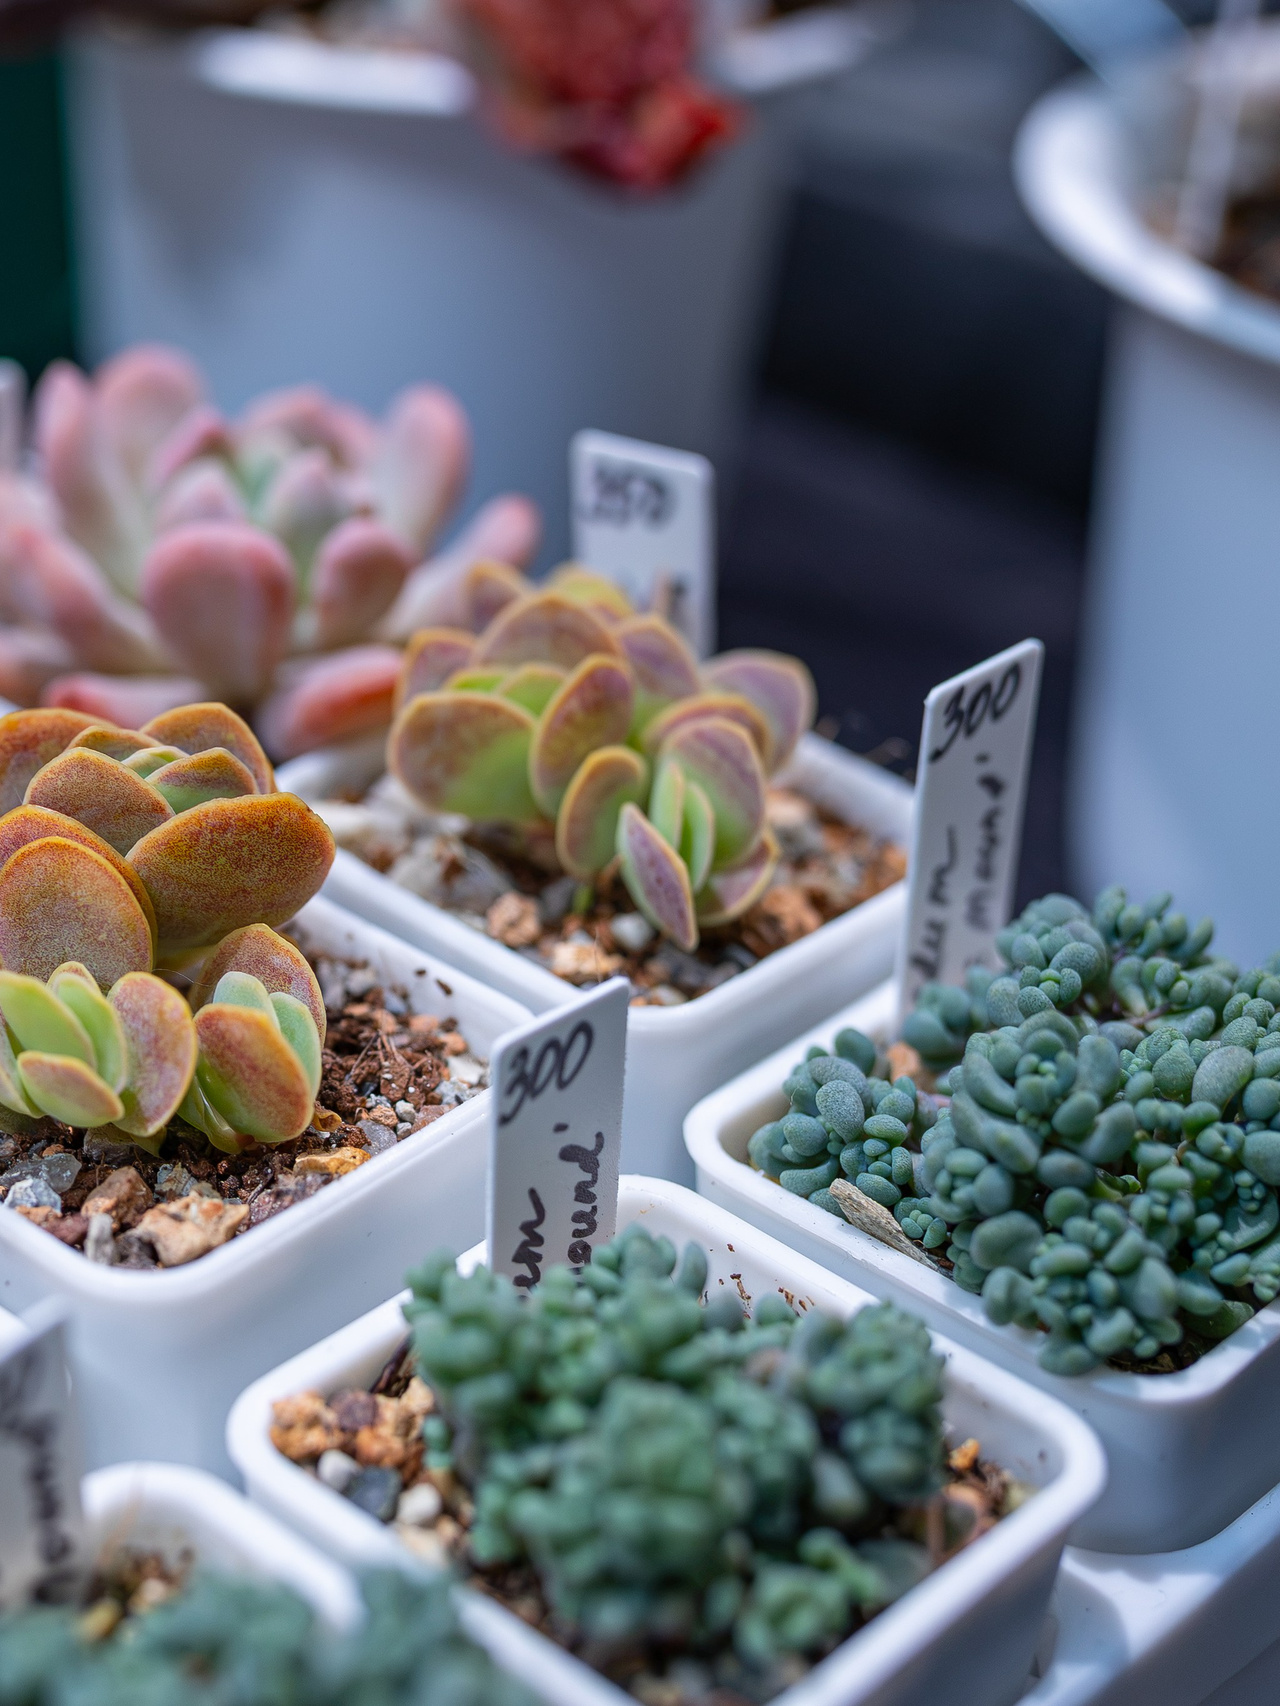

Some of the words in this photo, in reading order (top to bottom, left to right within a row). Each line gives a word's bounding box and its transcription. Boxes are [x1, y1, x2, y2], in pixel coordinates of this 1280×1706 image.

[928, 662, 1021, 764] 300
[908, 823, 959, 998] dum
[498, 1020, 595, 1126] 300
[512, 1187, 546, 1298] um
[552, 1122, 606, 1287] ound'
